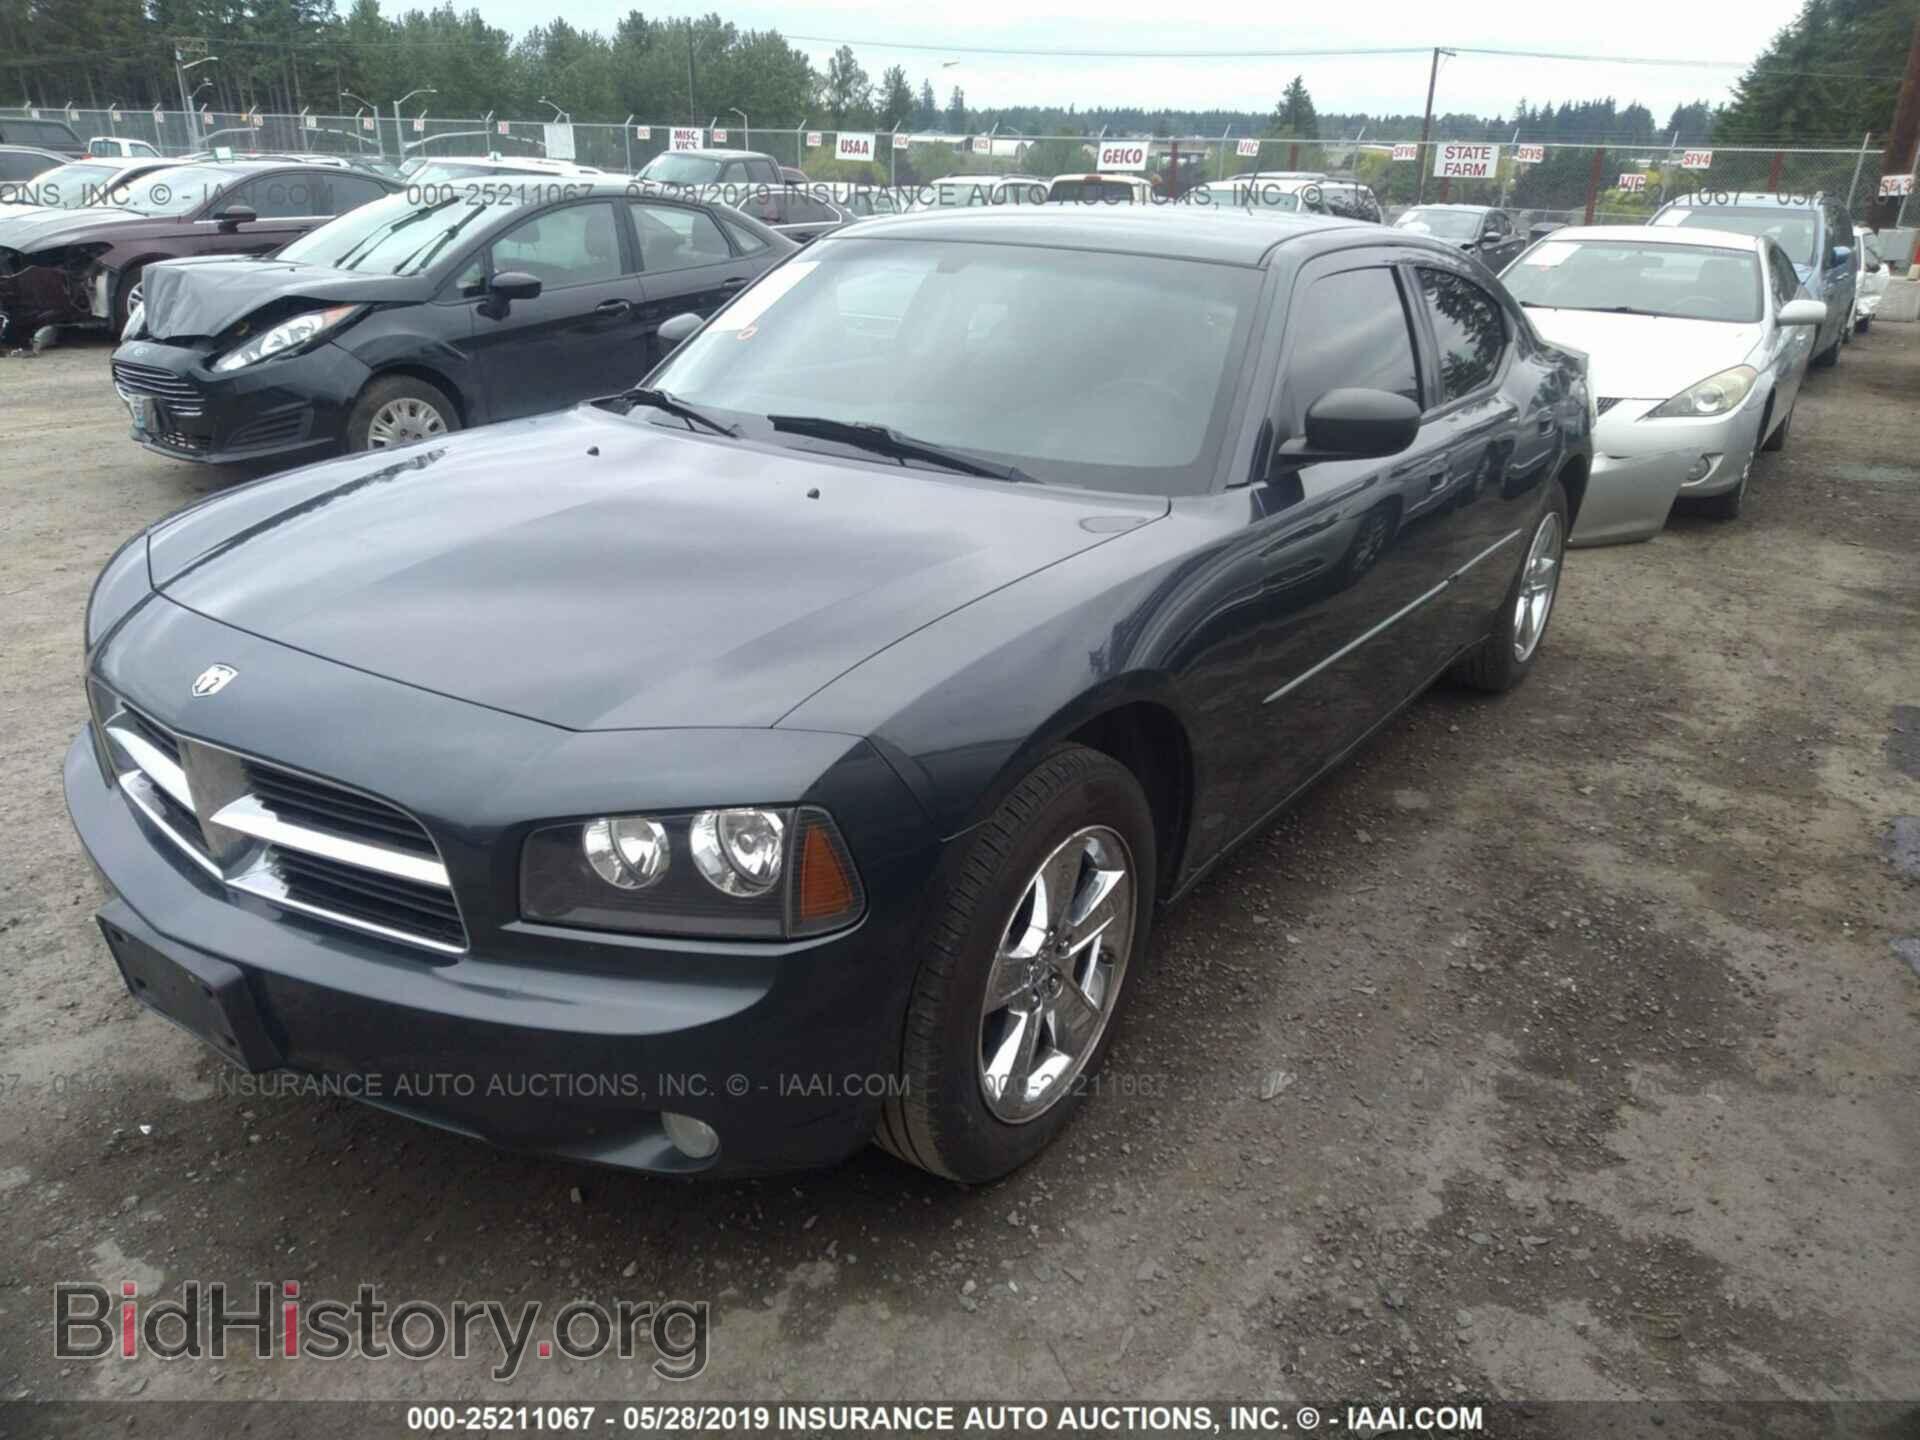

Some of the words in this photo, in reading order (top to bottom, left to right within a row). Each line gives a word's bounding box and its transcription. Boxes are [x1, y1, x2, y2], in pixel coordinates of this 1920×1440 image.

[674, 130, 699, 140] MISC.
[841, 140, 869, 154] USAA
[1444, 146, 1491, 160] STATE
[1103, 149, 1143, 163] GEICO
[1443, 163, 1487, 176] FARM
